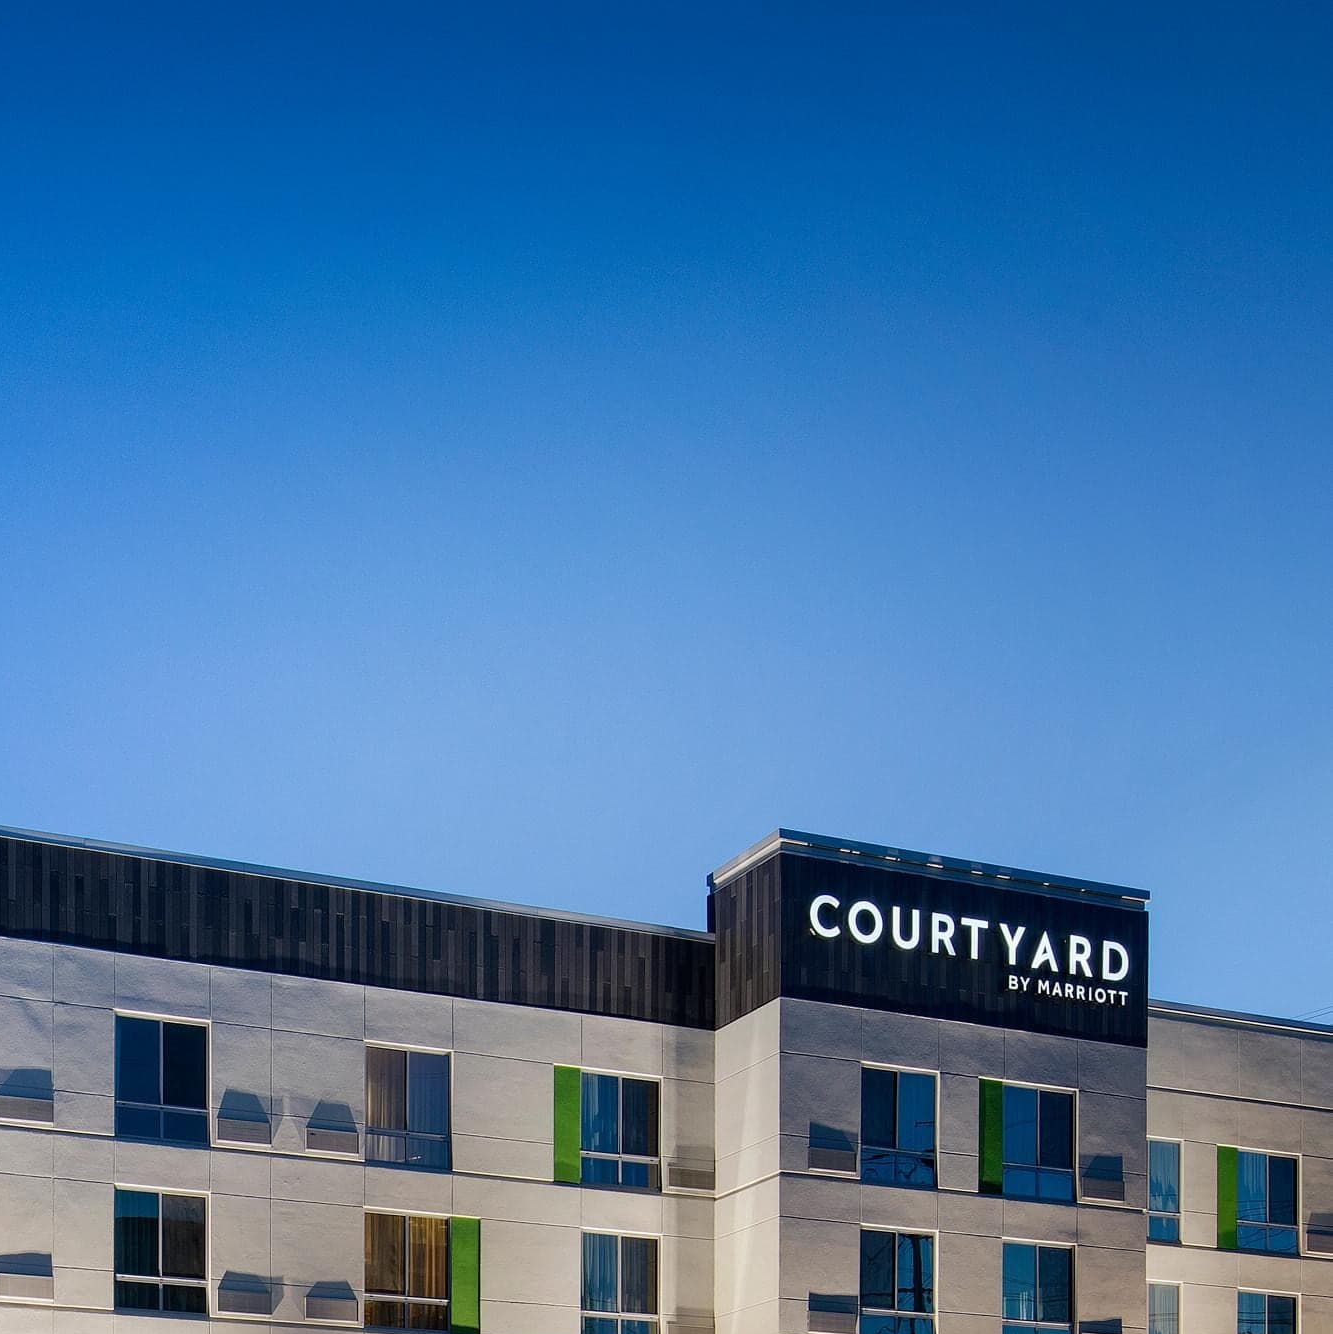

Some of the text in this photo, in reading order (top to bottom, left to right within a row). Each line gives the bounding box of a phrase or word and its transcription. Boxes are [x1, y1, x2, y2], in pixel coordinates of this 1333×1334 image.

[809, 894, 1130, 982] COURTYARD
[1008, 974, 1129, 1006] BY MARRIOTT
